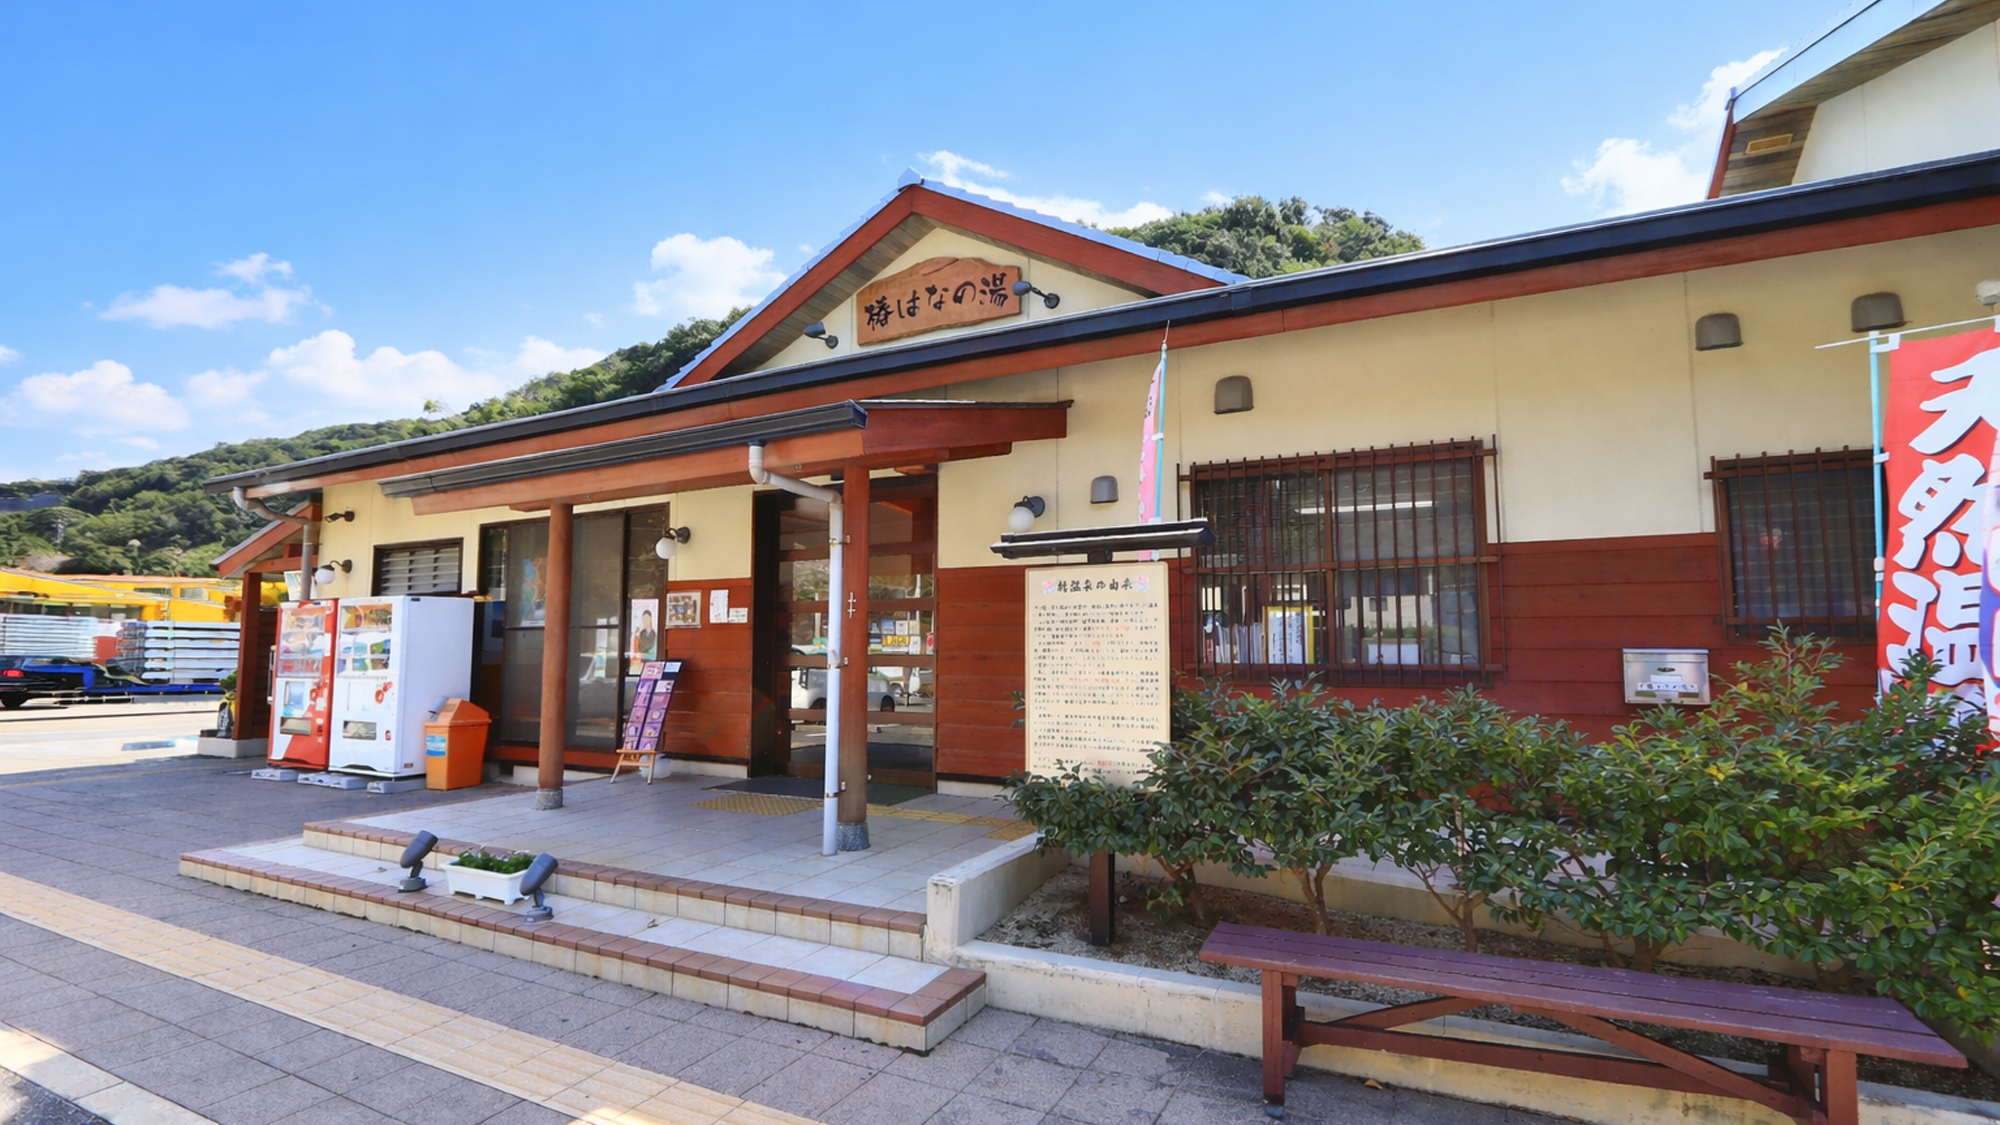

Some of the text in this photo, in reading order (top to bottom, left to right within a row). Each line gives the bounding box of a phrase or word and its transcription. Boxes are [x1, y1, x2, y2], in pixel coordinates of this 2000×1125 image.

[864, 272, 1009, 331] 椿はなの湯
[1881, 348, 2000, 728] 天然温
